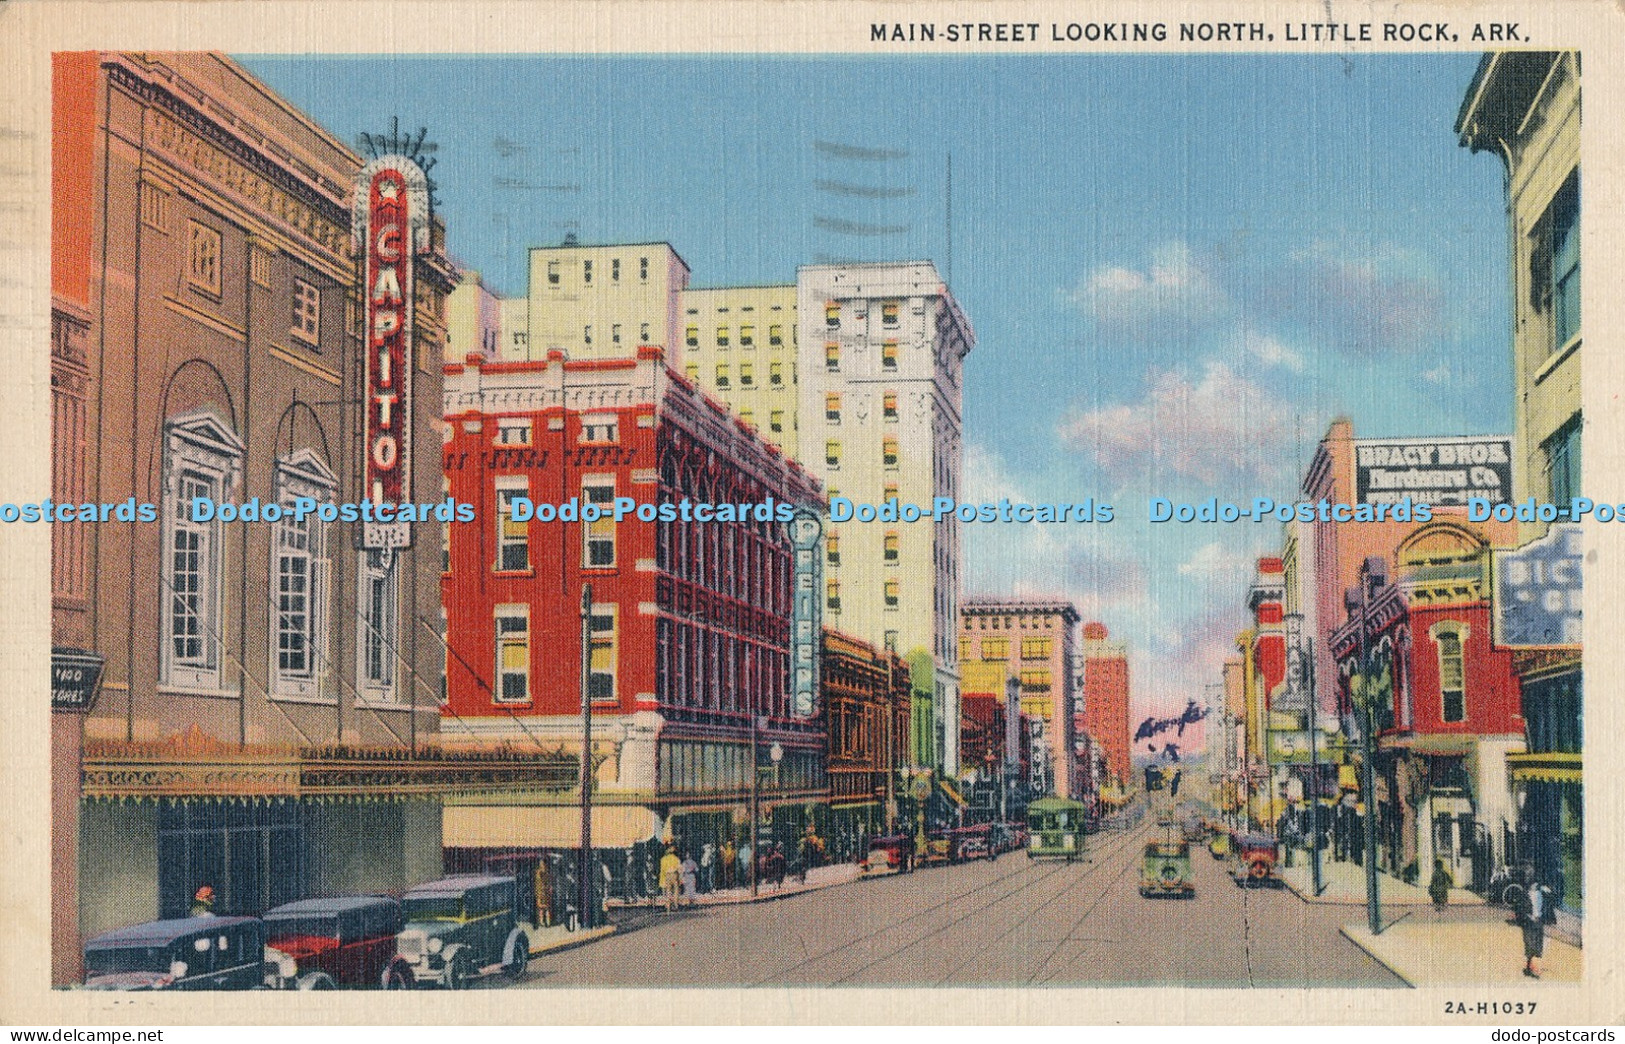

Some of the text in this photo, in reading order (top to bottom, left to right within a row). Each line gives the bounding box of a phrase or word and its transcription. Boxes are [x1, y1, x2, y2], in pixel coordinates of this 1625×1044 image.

[870, 23, 1531, 43] MAIN-STREET LOOKING NORTH, LITTLE ROCK, ARK.
[1359, 446, 1436, 466] BRACY
[1445, 1001, 1537, 1015] 2A-H1037
